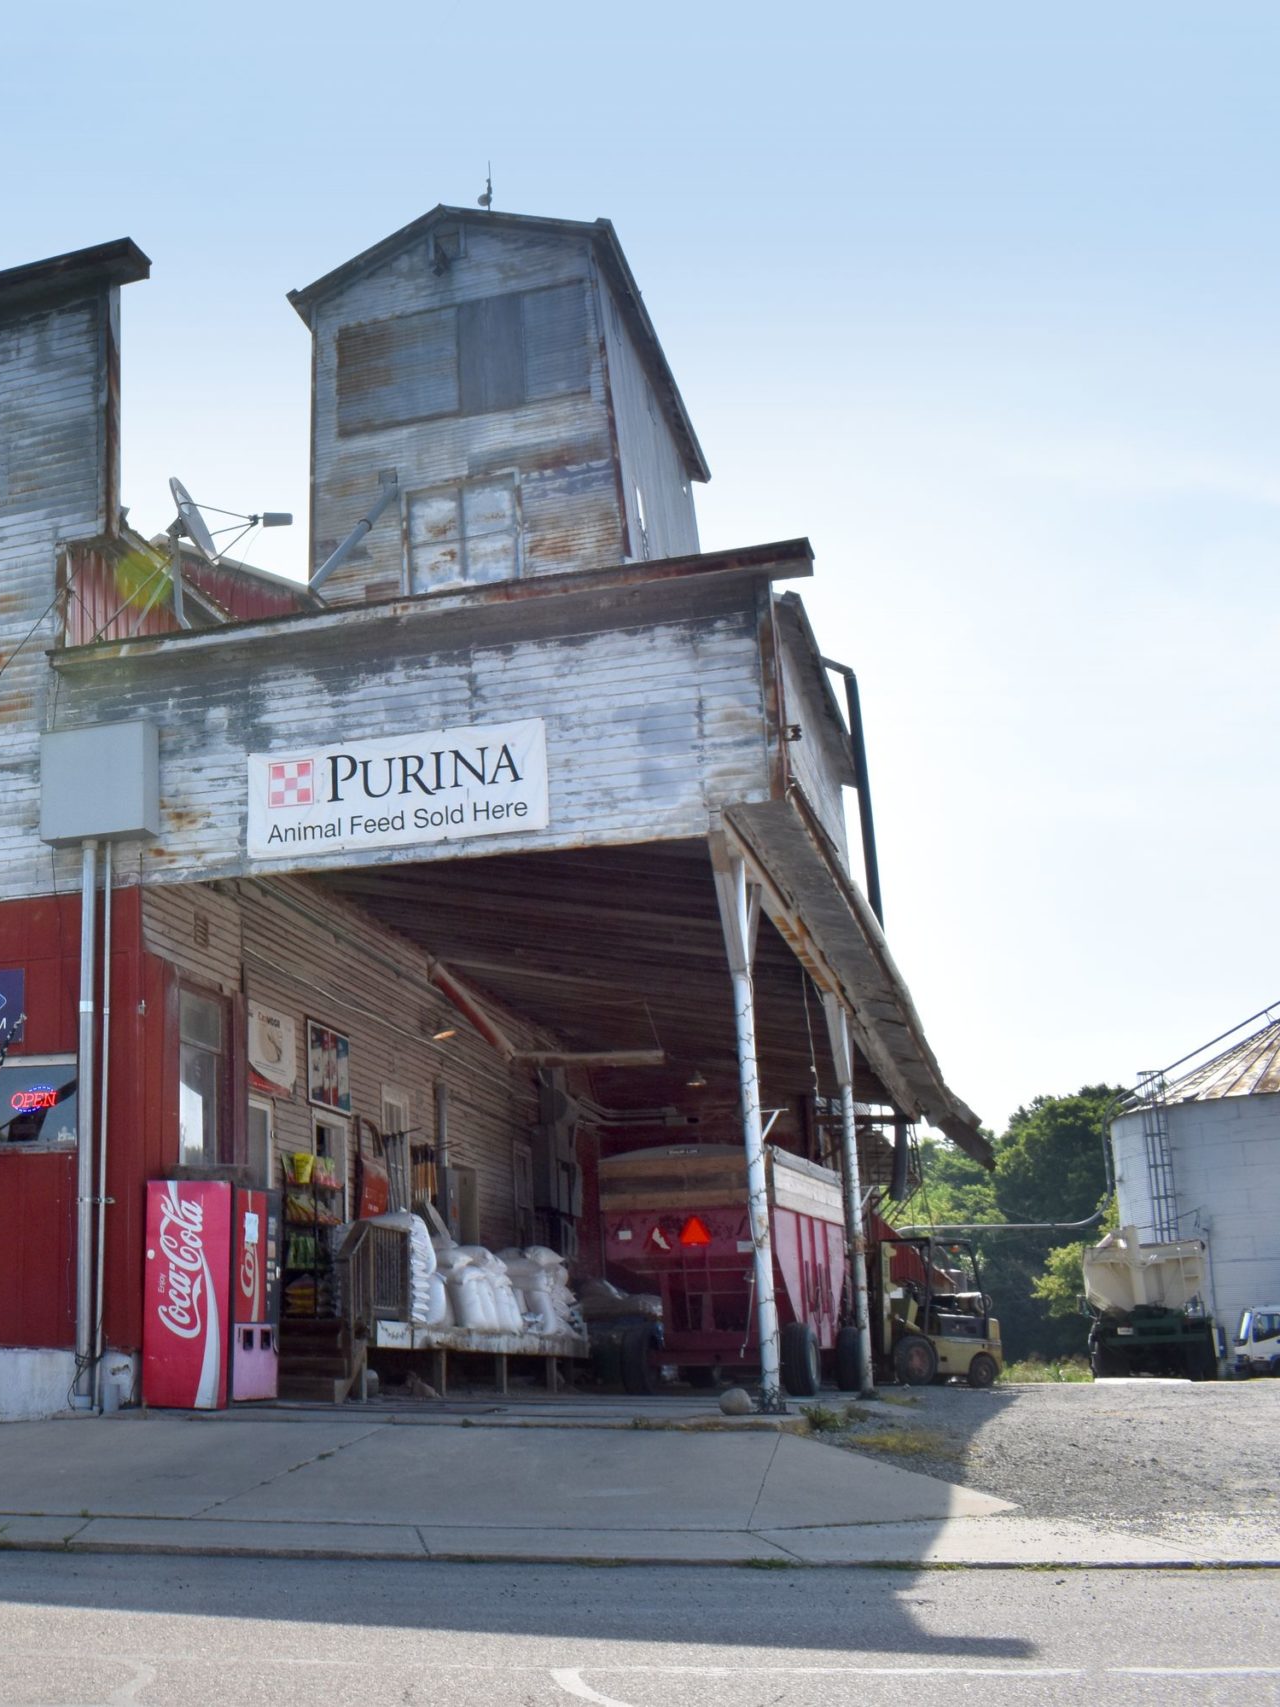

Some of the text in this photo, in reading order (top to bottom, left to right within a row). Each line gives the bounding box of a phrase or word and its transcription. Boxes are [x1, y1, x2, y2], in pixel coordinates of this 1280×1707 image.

[326, 743, 524, 803] PURINA
[267, 800, 528, 844] Animal Feed Sold Here
[11, 1090, 58, 1109] OPEN
[157, 1194, 204, 1339] Coca-Cola
